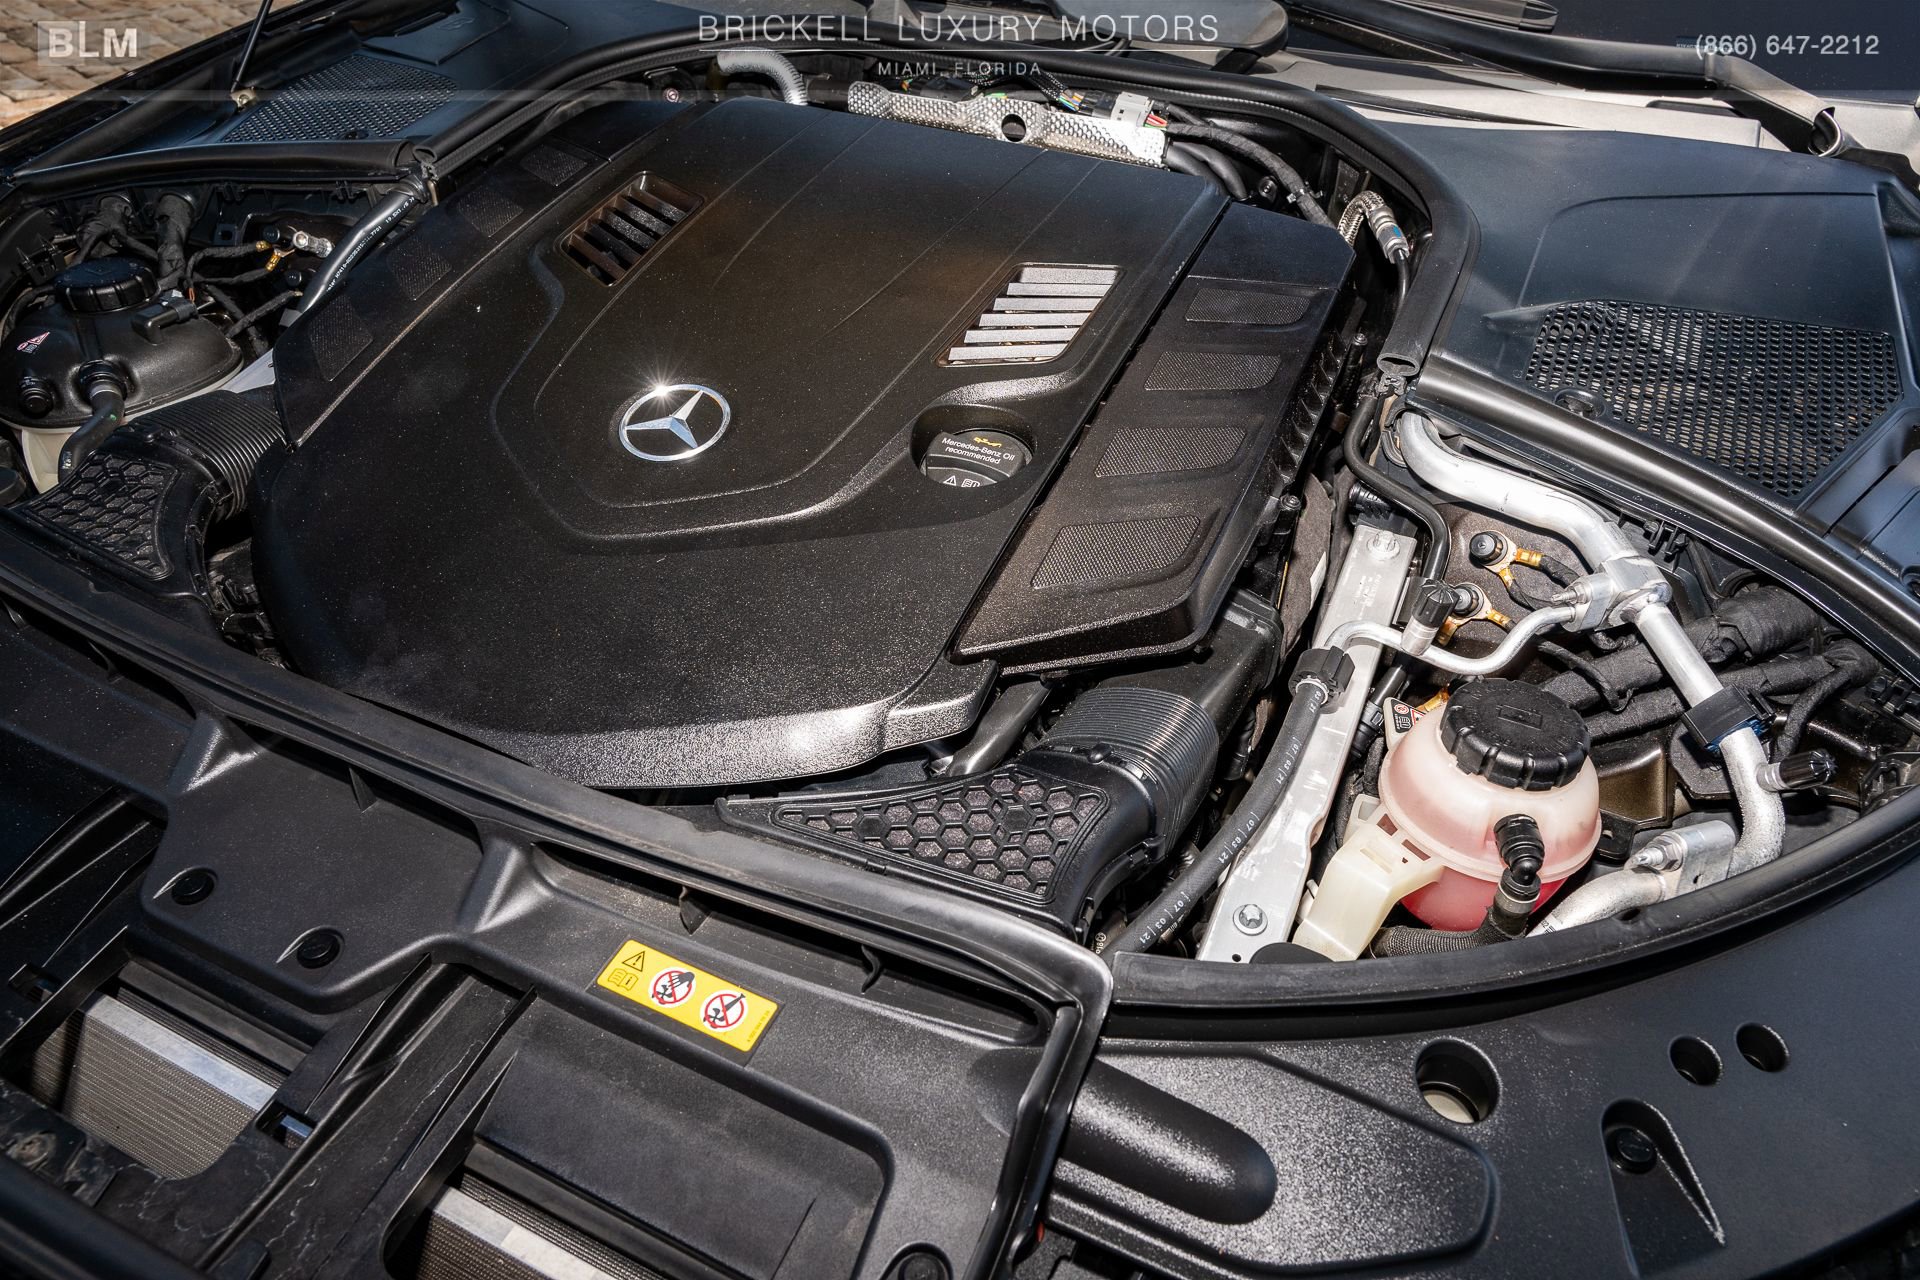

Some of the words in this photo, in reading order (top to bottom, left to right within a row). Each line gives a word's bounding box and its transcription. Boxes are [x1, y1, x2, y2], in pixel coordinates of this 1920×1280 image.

[941, 437, 1002, 458] Mercedes-Benz
[1003, 452, 1015, 461] Oil
[944, 446, 1001, 464] recommended
